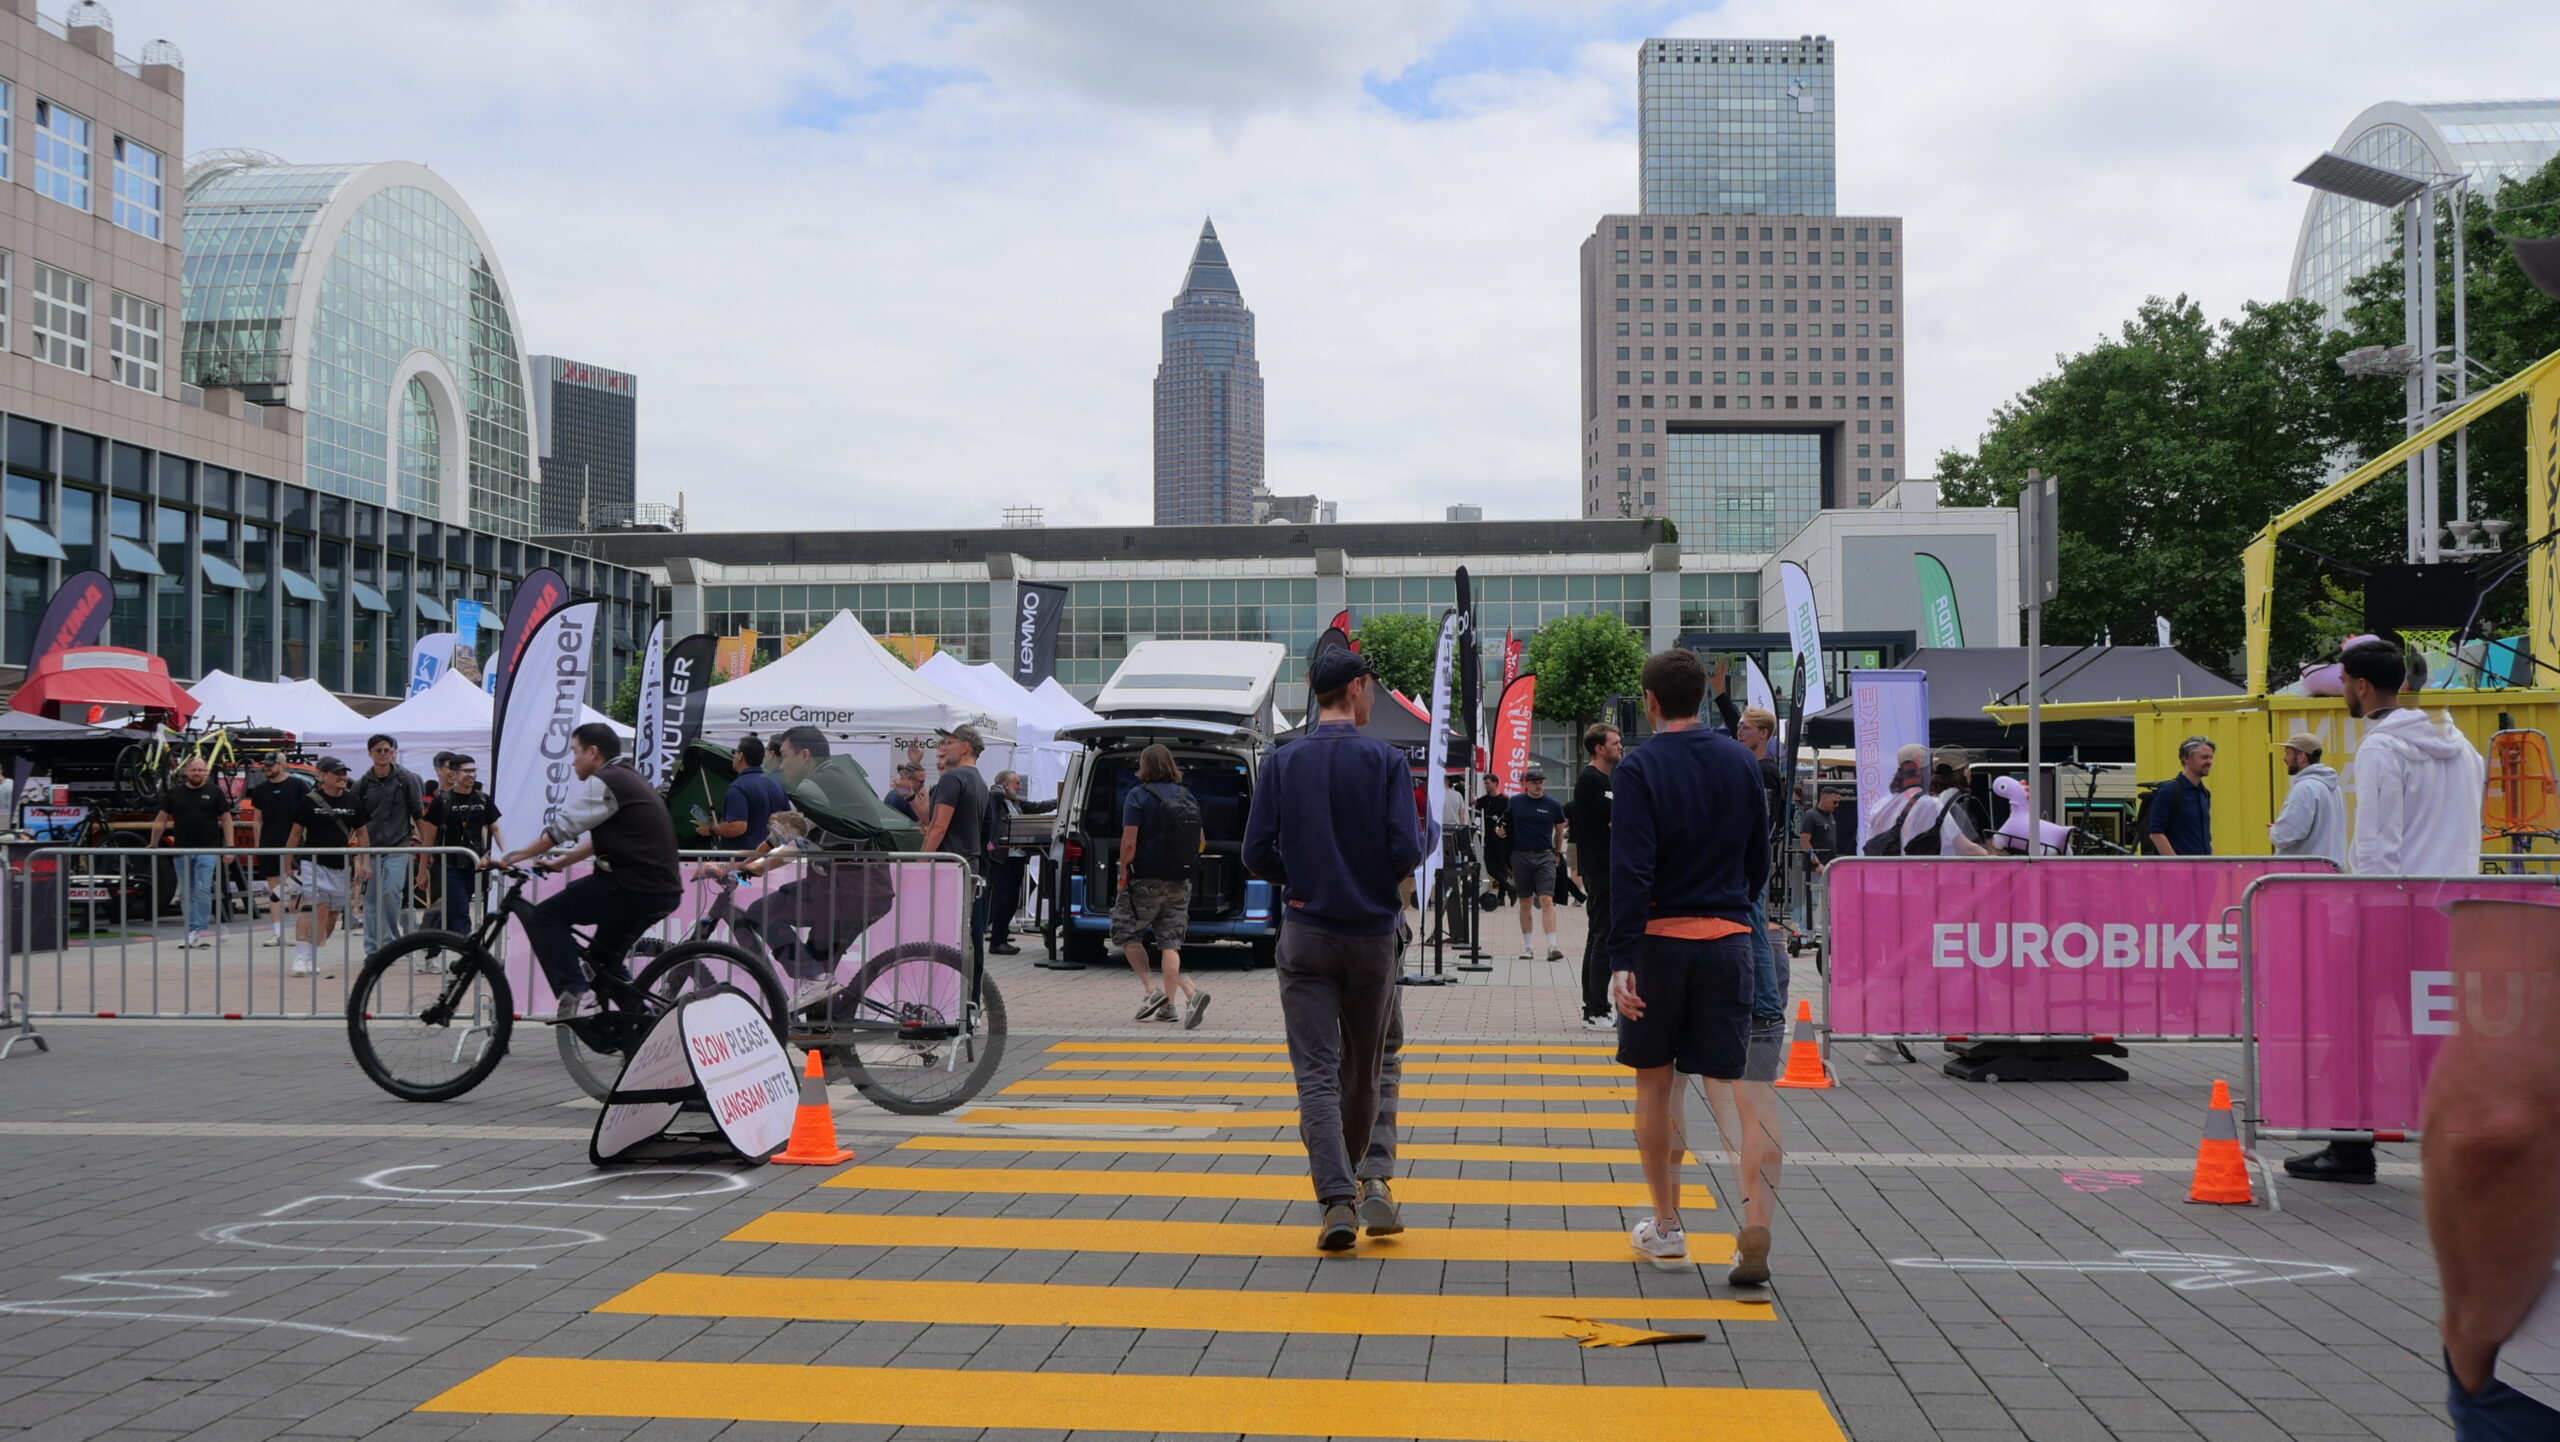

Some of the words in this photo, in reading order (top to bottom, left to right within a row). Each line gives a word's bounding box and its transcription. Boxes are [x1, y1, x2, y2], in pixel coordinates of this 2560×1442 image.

[47, 580, 104, 651] AKIMA
[739, 705, 854, 727] SpaceCamper
[1932, 922, 2239, 969] EUROBIKE
[692, 1031, 732, 1067] SLOW
[725, 1019, 769, 1057] PLEASE
[716, 1083, 769, 1126] LANGSAM
[764, 1070, 794, 1106] BITTE
